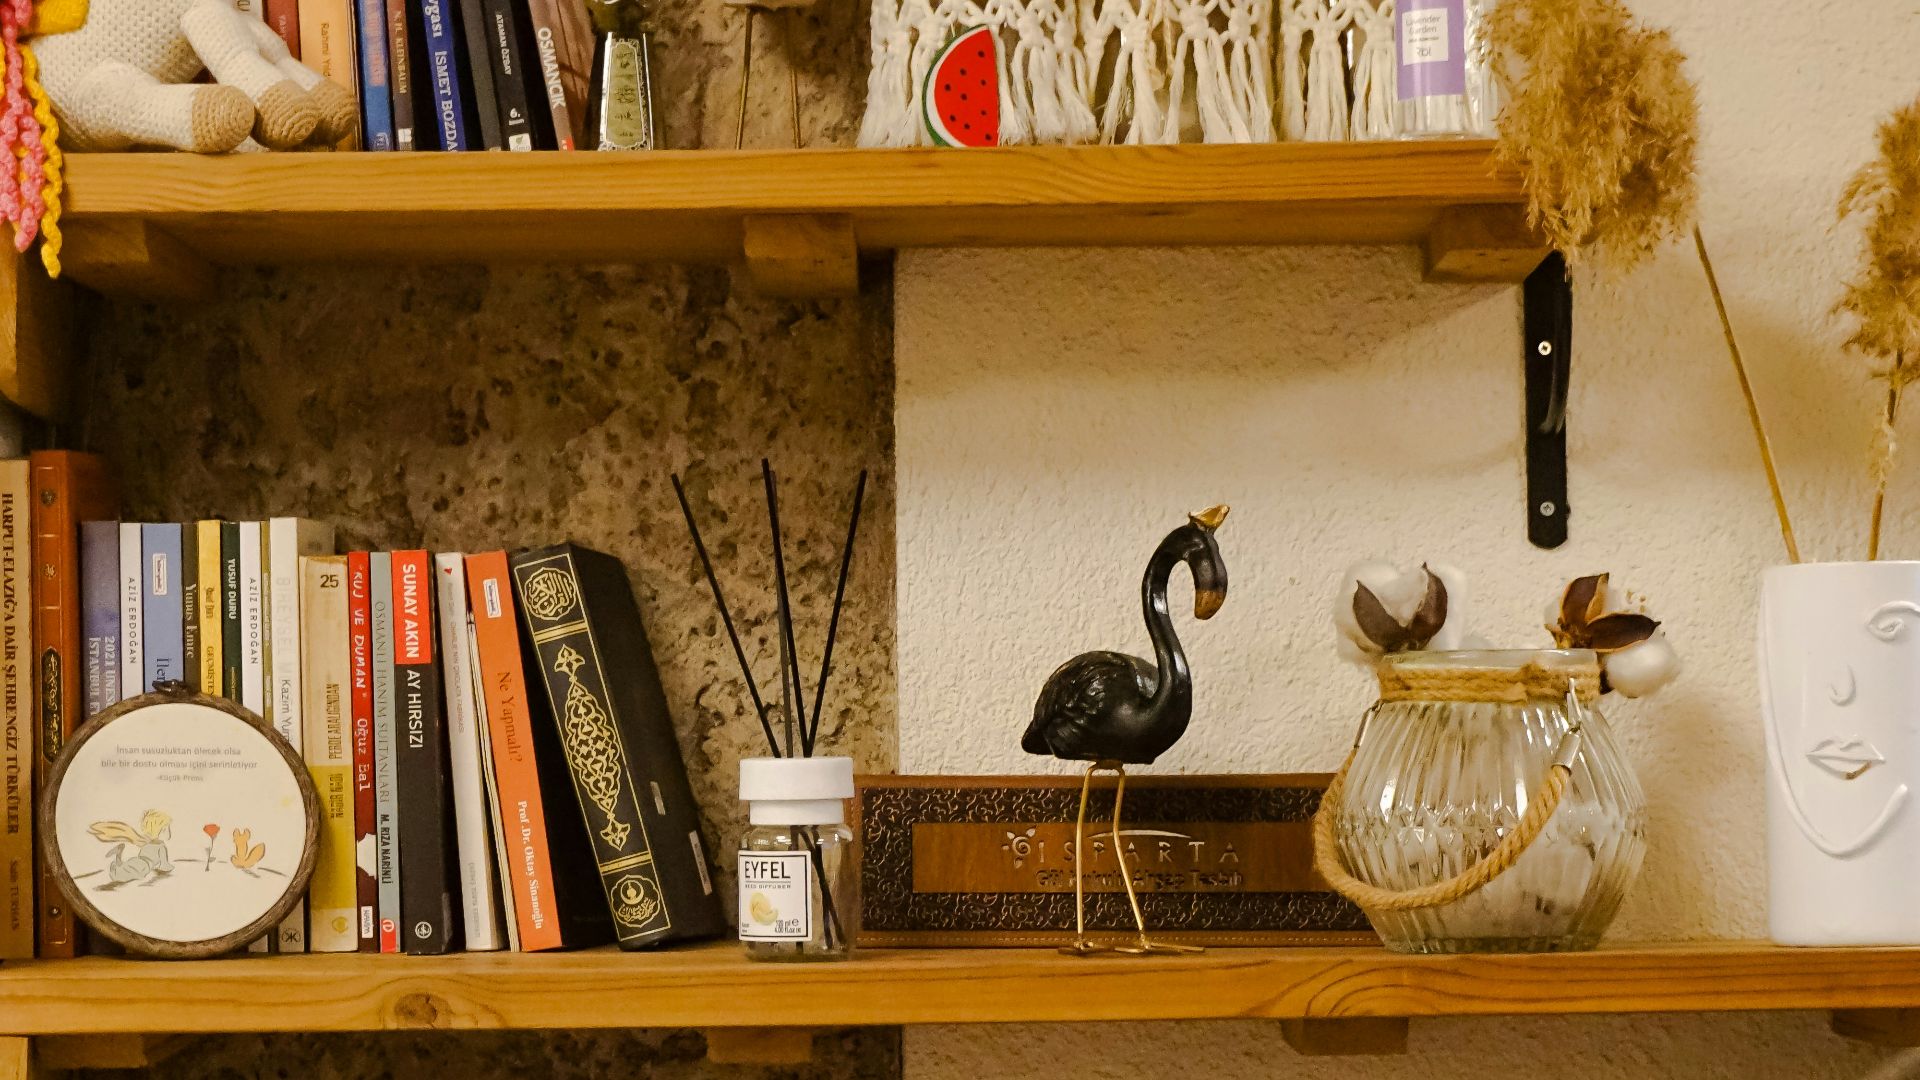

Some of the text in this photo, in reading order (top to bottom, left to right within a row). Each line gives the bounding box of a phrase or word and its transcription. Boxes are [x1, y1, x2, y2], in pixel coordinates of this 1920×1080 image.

[496, 14, 507, 47] ATAMAN
[538, 27, 566, 109] OSMANCIK
[441, 99, 459, 151] BOZDA
[228, 558, 237, 620] YUSUF DURU
[320, 574, 339, 589] 25
[129, 577, 139, 664] AZİZ ERDOĞAN
[185, 583, 198, 659] Yunus Emre
[249, 578, 259, 665] AZİZ ERDOĞAN
[354, 608, 364, 626] VE
[402, 563, 420, 658] SUNAY AKIN
[4, 627, 19, 662] DAİR
[89, 637, 101, 696] İSTANBUL
[104, 636, 116, 667] 2021
[3, 664, 20, 750] ŞEHRENGİZ
[281, 679, 293, 715] Kazım
[375, 601, 390, 803] OSMANLI HANIM SULTANLARI
[406, 669, 424, 749] AY HIRSIZI
[498, 671, 523, 762] Ne Yapmalı?
[101, 760, 116, 768] bile
[119, 760, 130, 768] bir
[133, 760, 157, 768] dostu
[116, 744, 140, 754] İnsan
[224, 746, 241, 755] olsa
[328, 736, 342, 760] PERDE
[357, 718, 371, 792] Oğuz Bal
[6, 753, 21, 834] TÜRKÜLER
[380, 814, 393, 884] M. RIZA NARİNLİ
[525, 845, 536, 877] Oktay
[744, 861, 791, 879] EYFEL
[1038, 841, 1238, 863] ISPARTA
[529, 879, 544, 929] Sinanoğlu
